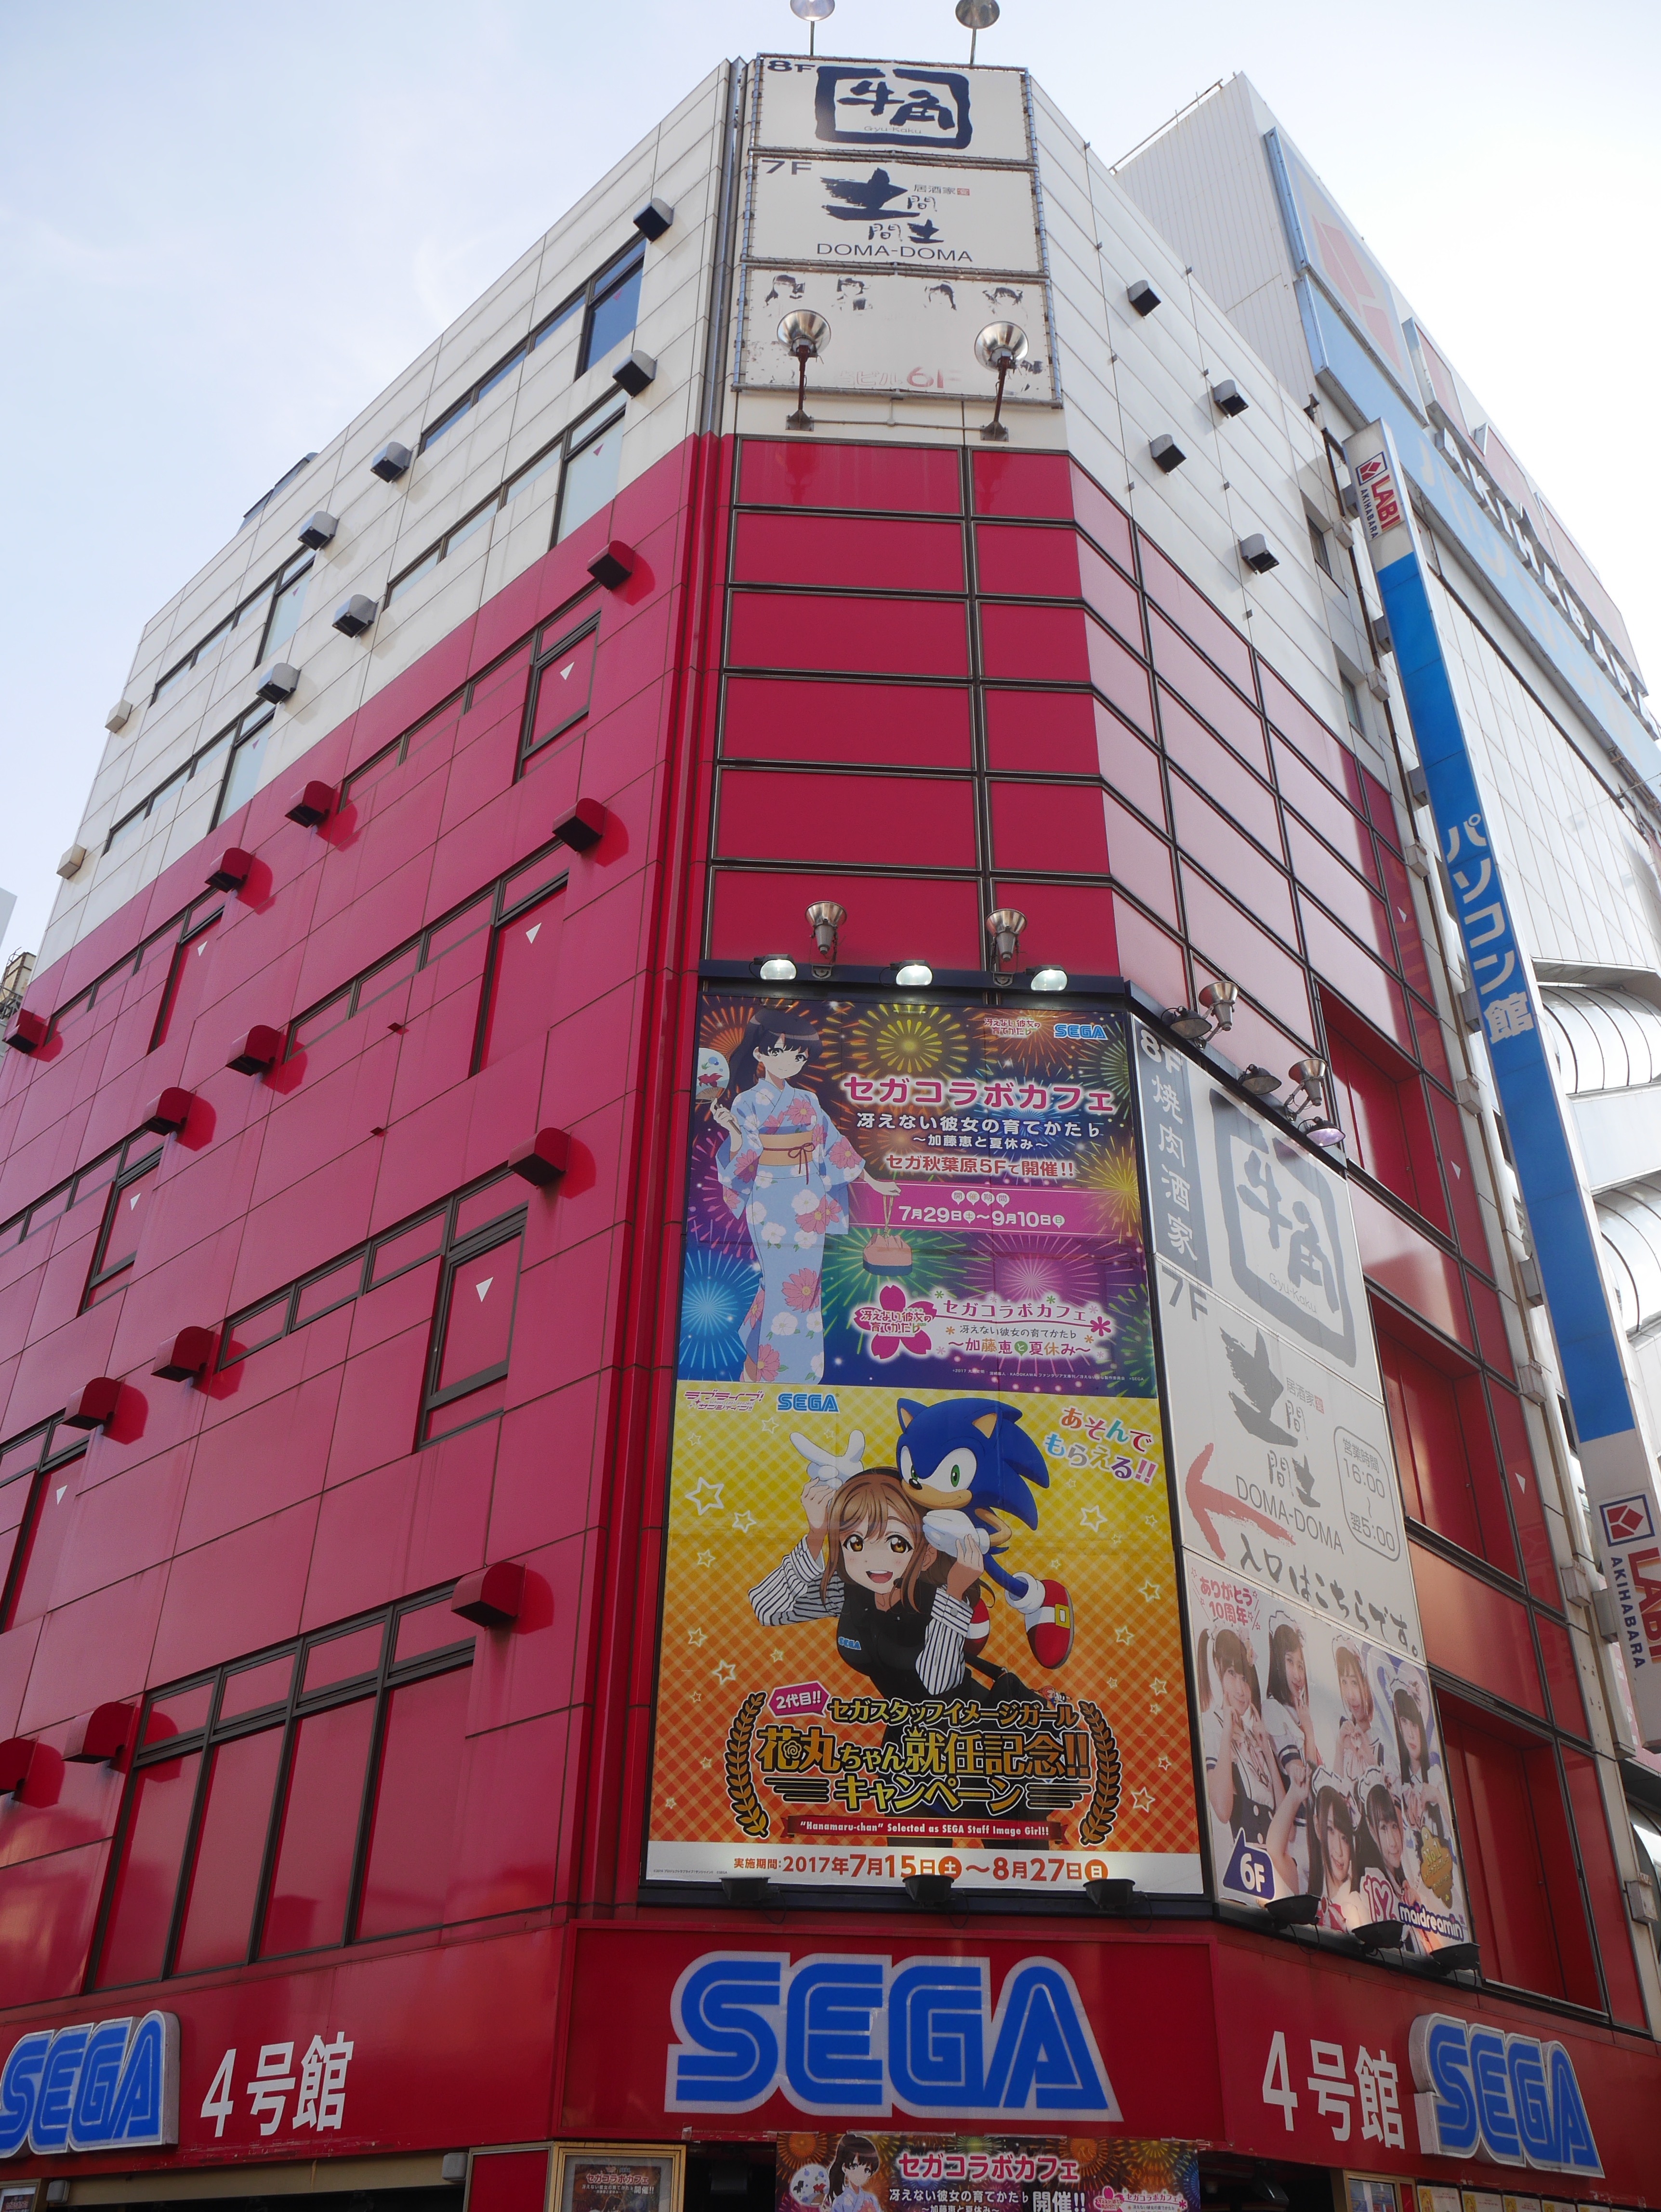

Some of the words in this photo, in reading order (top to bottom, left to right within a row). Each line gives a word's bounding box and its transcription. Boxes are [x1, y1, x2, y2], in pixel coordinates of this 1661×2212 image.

[767, 60, 815, 72] 8F
[837, 80, 955, 130] 牛角
[864, 126, 922, 134] Gyu-Kaku
[762, 159, 812, 175] 7F
[817, 243, 973, 262] DOMA-DOMA
[1360, 488, 1379, 539] AKIHABARA
[1371, 474, 1401, 532] LABI
[1444, 427, 1661, 739] AKIHABARA
[1447, 813, 1535, 1044] パソコン館
[1054, 1023, 1108, 1040] SEGA
[1140, 1029, 1184, 1074] 8F
[843, 1076, 1115, 1112] セガコラボカフェ
[886, 1154, 1074, 1177] セガ秋葉原5Fで開催!!
[1151, 1074, 1198, 1261] 焼肉酒家
[954, 1192, 1007, 1202] 開催期間
[1236, 1149, 1340, 1314] 牛角
[943, 1299, 1087, 1322] セガコラボカフェ
[1161, 1264, 1208, 1322] 7F
[1269, 1272, 1318, 1314] Gyu-Kaku
[685, 1389, 765, 1402] ラブライブ!
[777, 1393, 840, 1413] SEGA
[1061, 1407, 1152, 1452] あそんで
[1045, 1433, 1156, 1484] もらえる!!
[1343, 1437, 1380, 1474] 営業時間
[1343, 1458, 1385, 1499] 16:00
[1236, 1475, 1345, 1555] DOMA-DOMA
[1349, 1511, 1395, 1552] 翌5:00
[1200, 1576, 1253, 1606] ありがとう
[1240, 1532, 1419, 1658] 入口はこちらです。
[1209, 1601, 1250, 1626] 10周年
[1610, 1556, 1646, 1669] AKIHABARA
[838, 1636, 861, 1650] SEGA
[776, 1691, 821, 1709] 2代目!!
[830, 1699, 1078, 1728] セガスタッフイメージガール
[757, 1726, 1090, 1777] 花丸ちゃん就任記念!!
[836, 1775, 1021, 1813] キャンペーン
[887, 1823, 925, 1833] Selected
[942, 1824, 964, 1833] SEGA
[967, 1825, 990, 1834] Staff
[993, 1825, 1021, 1836] Image
[1024, 1826, 1049, 1835] Girl!!
[1240, 1853, 1266, 1893] 6F
[1399, 1904, 1464, 1941] maidreamin
[664, 1950, 1124, 2122] SEGA
[0, 2010, 173, 2159] SEGA
[200, 2031, 354, 2138] 4号館
[1262, 2030, 1406, 2149] 4号館
[1416, 2013, 1606, 2178] SEGA
[586, 2173, 649, 2185] セガコラボカフェ
[898, 2151, 1079, 2182] セガコラボカフェ
[1033, 2191, 1086, 2212] 開催!!
[1127, 2193, 1177, 2202] セガコラボカフェ
